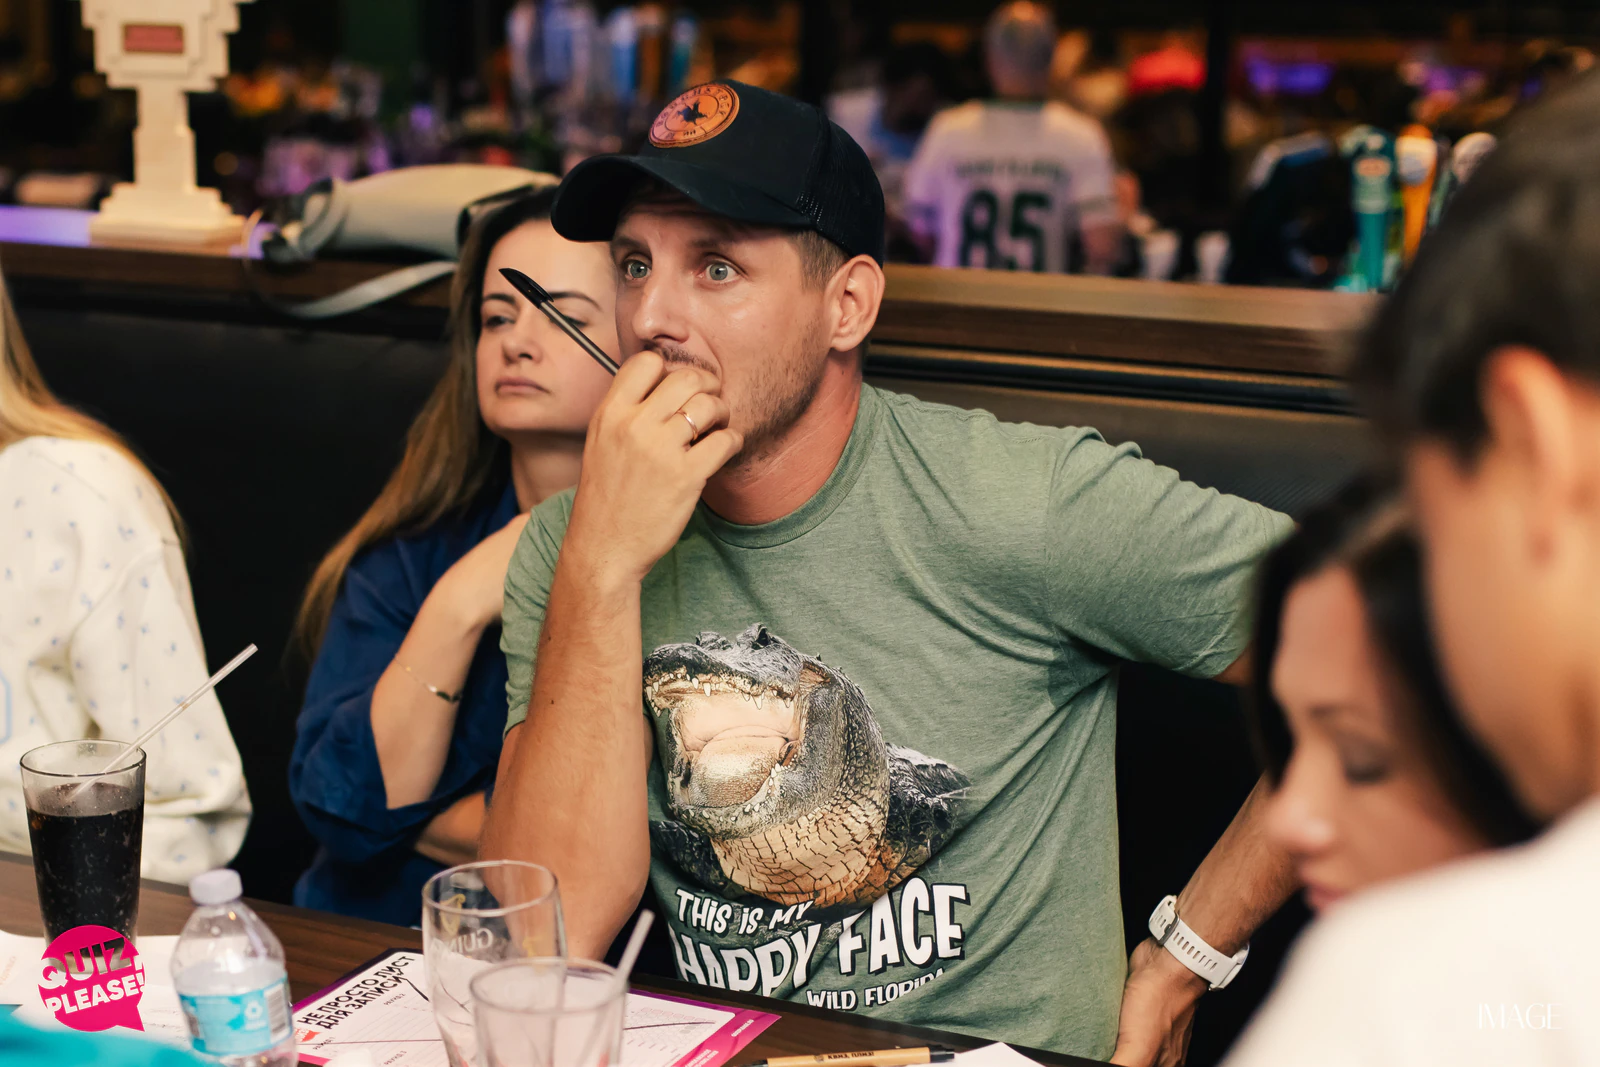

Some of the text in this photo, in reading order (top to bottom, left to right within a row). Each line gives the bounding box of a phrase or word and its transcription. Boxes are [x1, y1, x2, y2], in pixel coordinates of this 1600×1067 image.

[957, 189, 1052, 271] 85
[668, 877, 967, 998] HAPPY FACE
[768, 900, 814, 930] MY
[297, 956, 416, 1025] НЕ ПРОСТО ЛИСТ
[315, 975, 406, 1030] ДЛЯ ЗАПИСИ
